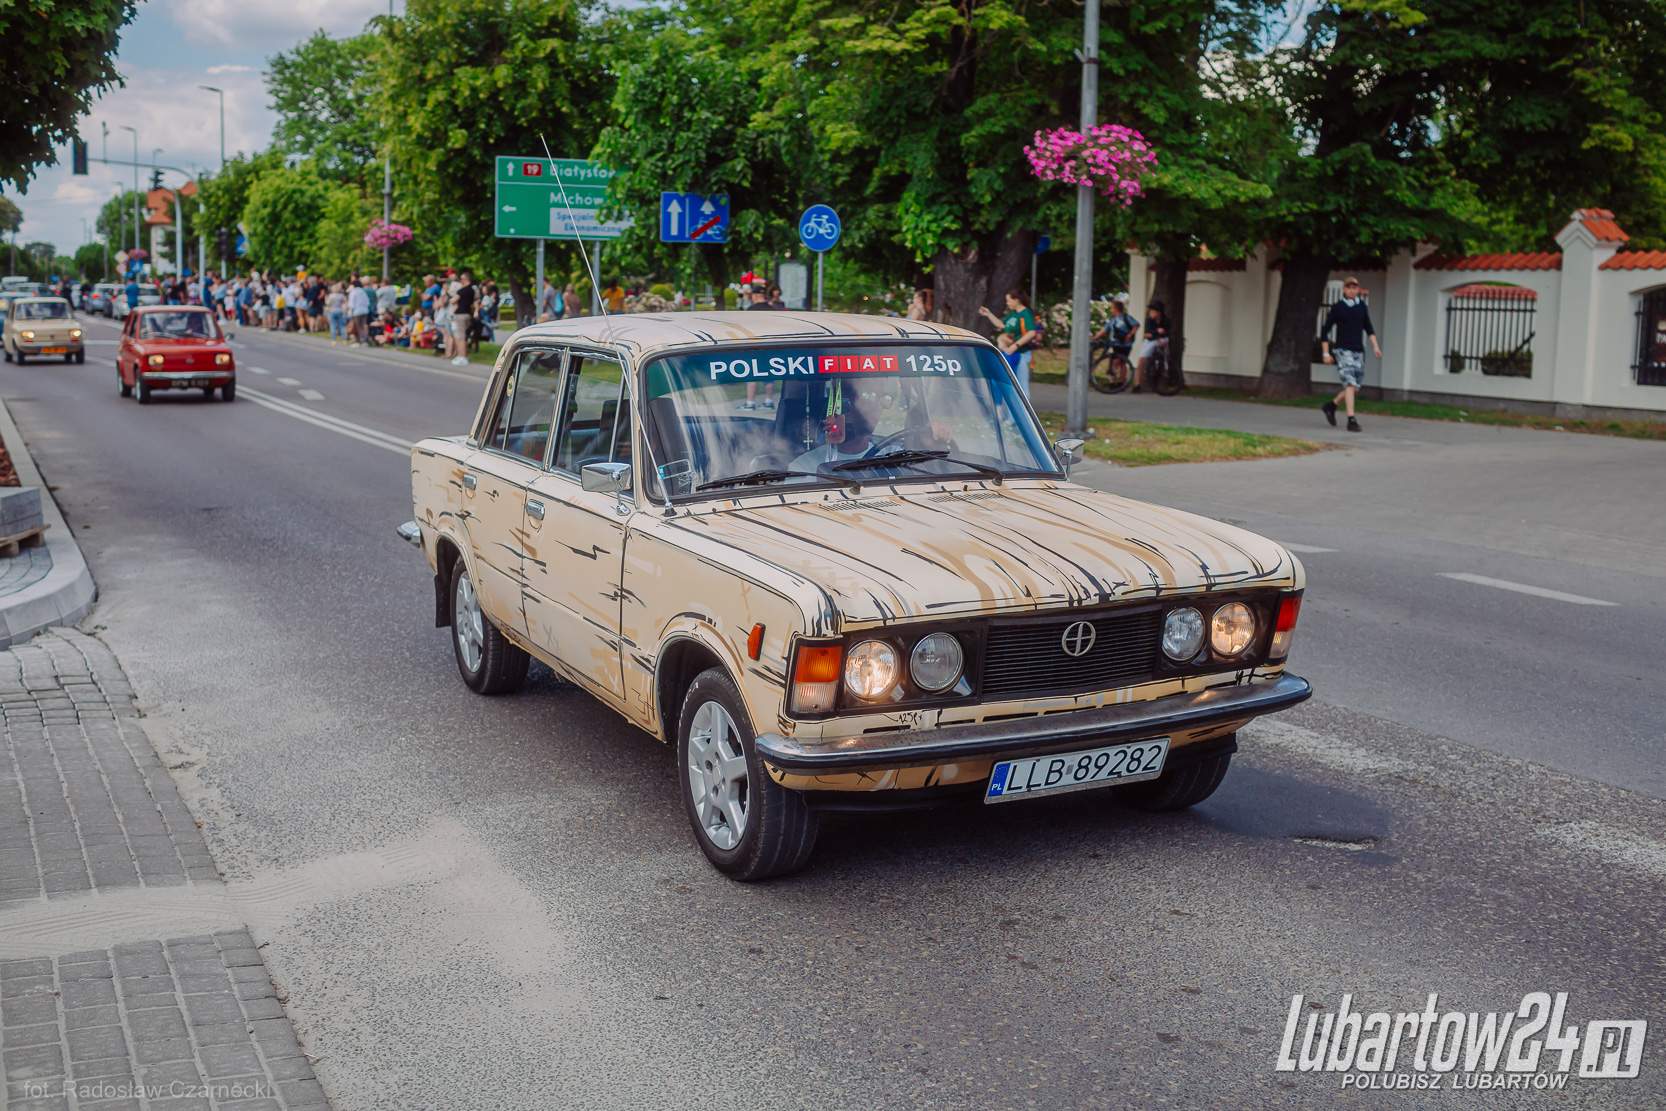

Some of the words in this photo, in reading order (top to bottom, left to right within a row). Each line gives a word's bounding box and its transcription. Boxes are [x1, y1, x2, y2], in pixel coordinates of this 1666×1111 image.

[709, 356, 815, 380] POLSKI
[822, 357, 896, 371] FIAT
[905, 355, 962, 376] 125p
[991, 783, 1002, 792] PL
[1007, 759, 1066, 792] LLB
[1073, 744, 1162, 781] 89282
